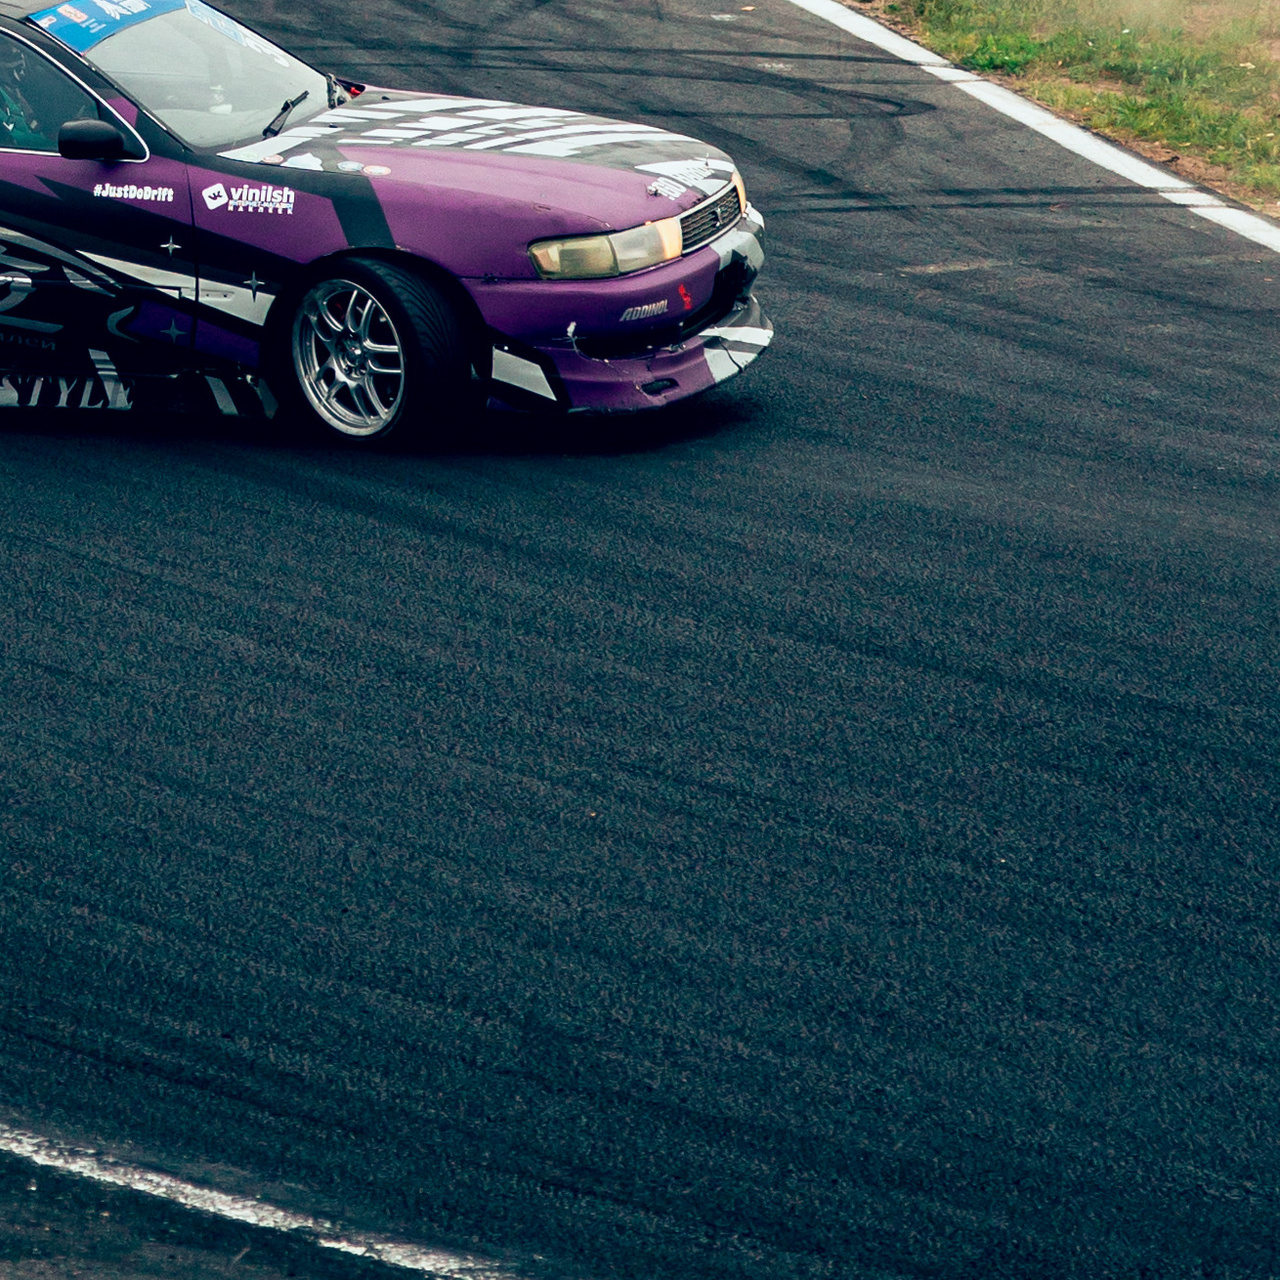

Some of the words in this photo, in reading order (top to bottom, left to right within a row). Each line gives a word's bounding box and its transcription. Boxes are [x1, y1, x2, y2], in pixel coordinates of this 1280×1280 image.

[93, 183, 174, 202] #JustDoDrift
[230, 184, 295, 202] vinilsh
[619, 299, 669, 322] ADDINOL
